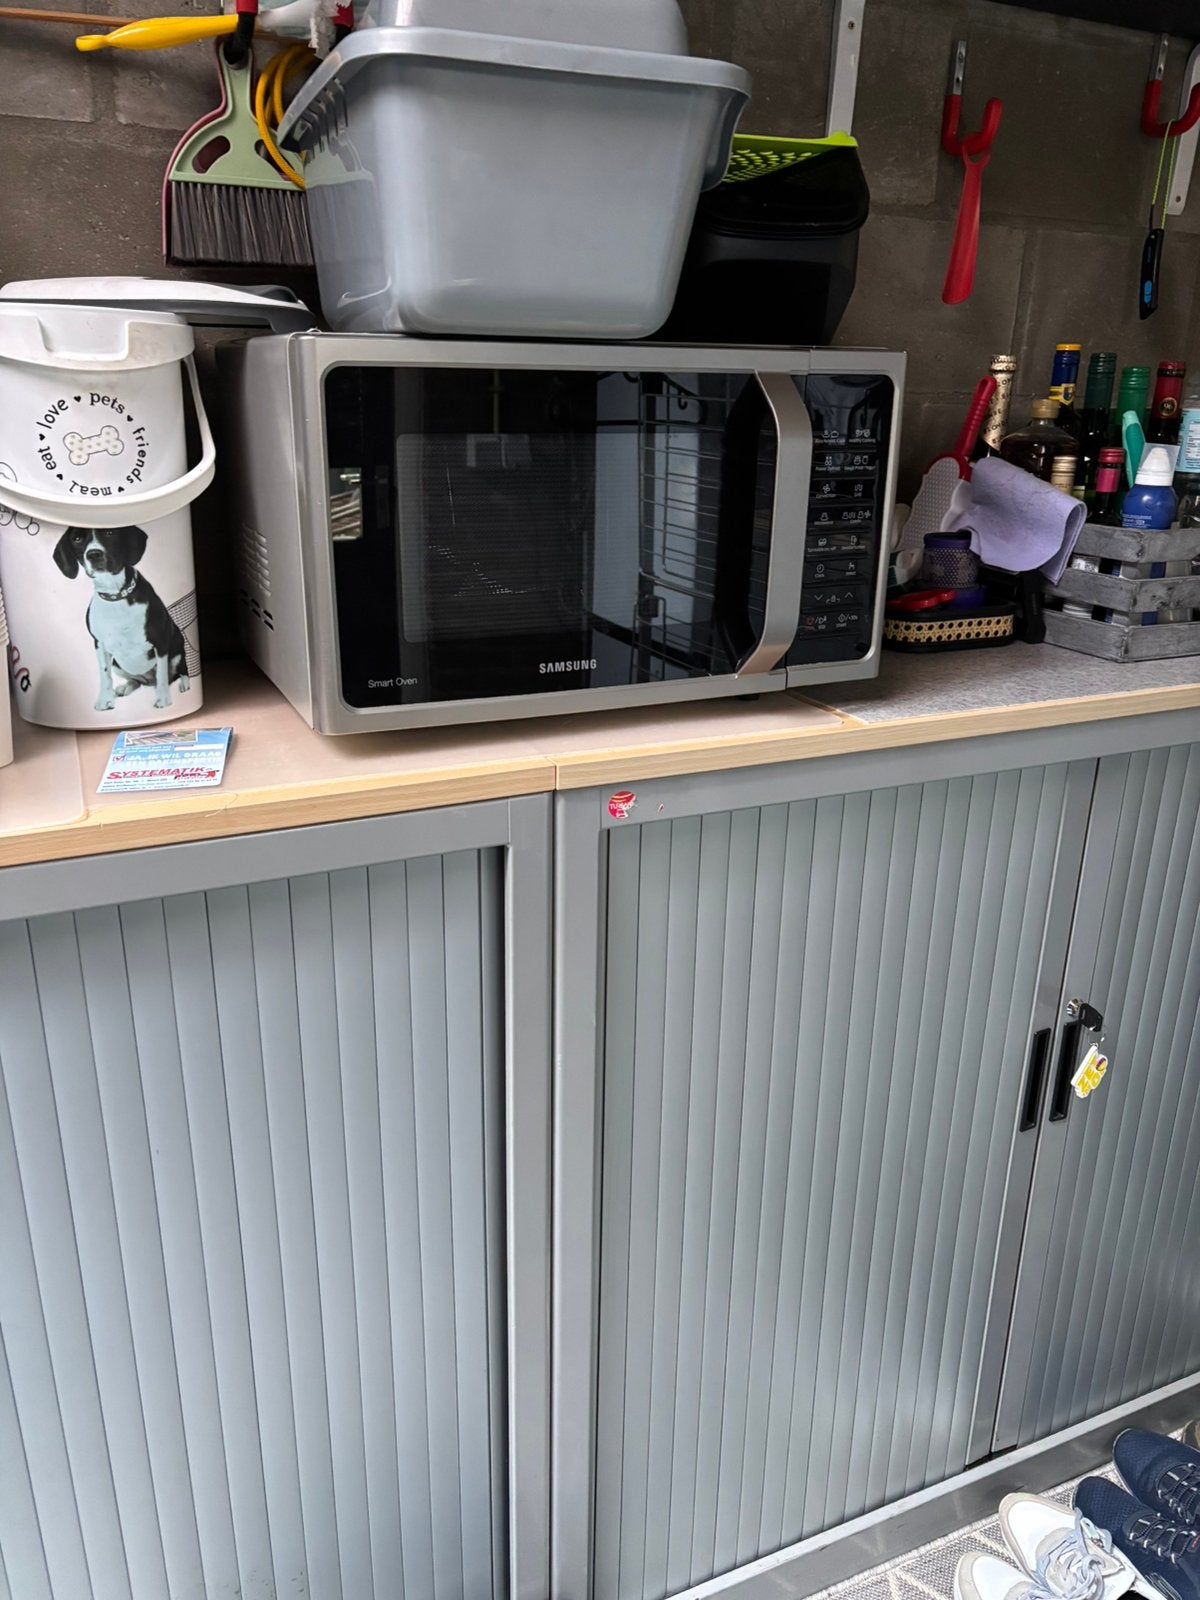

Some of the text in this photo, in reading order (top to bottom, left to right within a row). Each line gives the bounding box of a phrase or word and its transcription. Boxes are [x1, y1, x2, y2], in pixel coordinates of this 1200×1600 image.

[36, 392, 150, 497] love pets friends meal eat
[538, 659, 597, 674] SAMSUNG
[367, 676, 418, 688] Smart Oven
[106, 767, 206, 780] SYSTEMATIK
